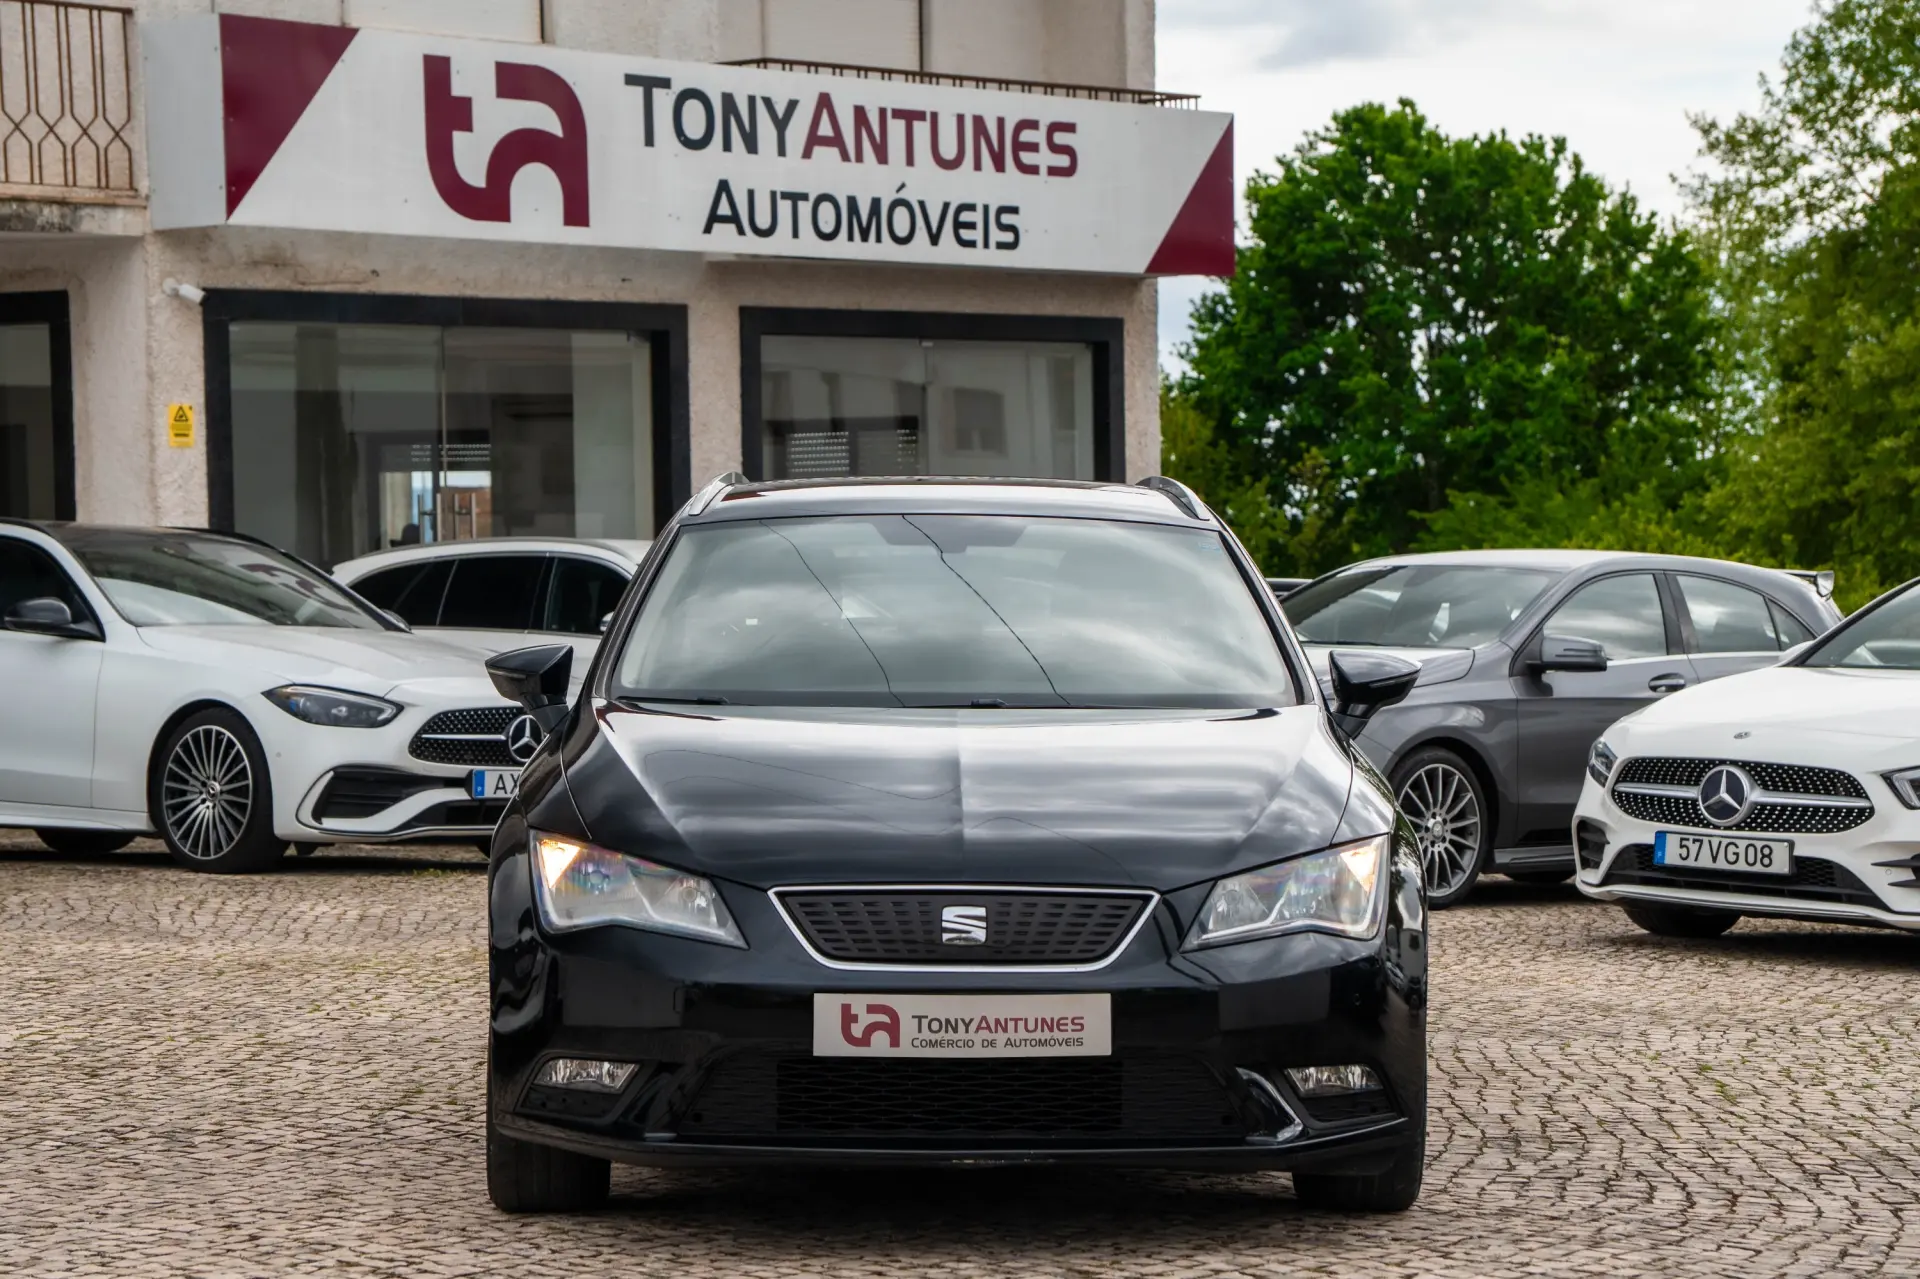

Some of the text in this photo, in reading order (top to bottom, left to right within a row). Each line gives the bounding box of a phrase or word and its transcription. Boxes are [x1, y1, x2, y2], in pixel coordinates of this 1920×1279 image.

[702, 179, 1020, 251] AUTOMÓVEIS
[911, 1035, 1084, 1048] COMÉRCIO DE AUTOMÓVEIS
